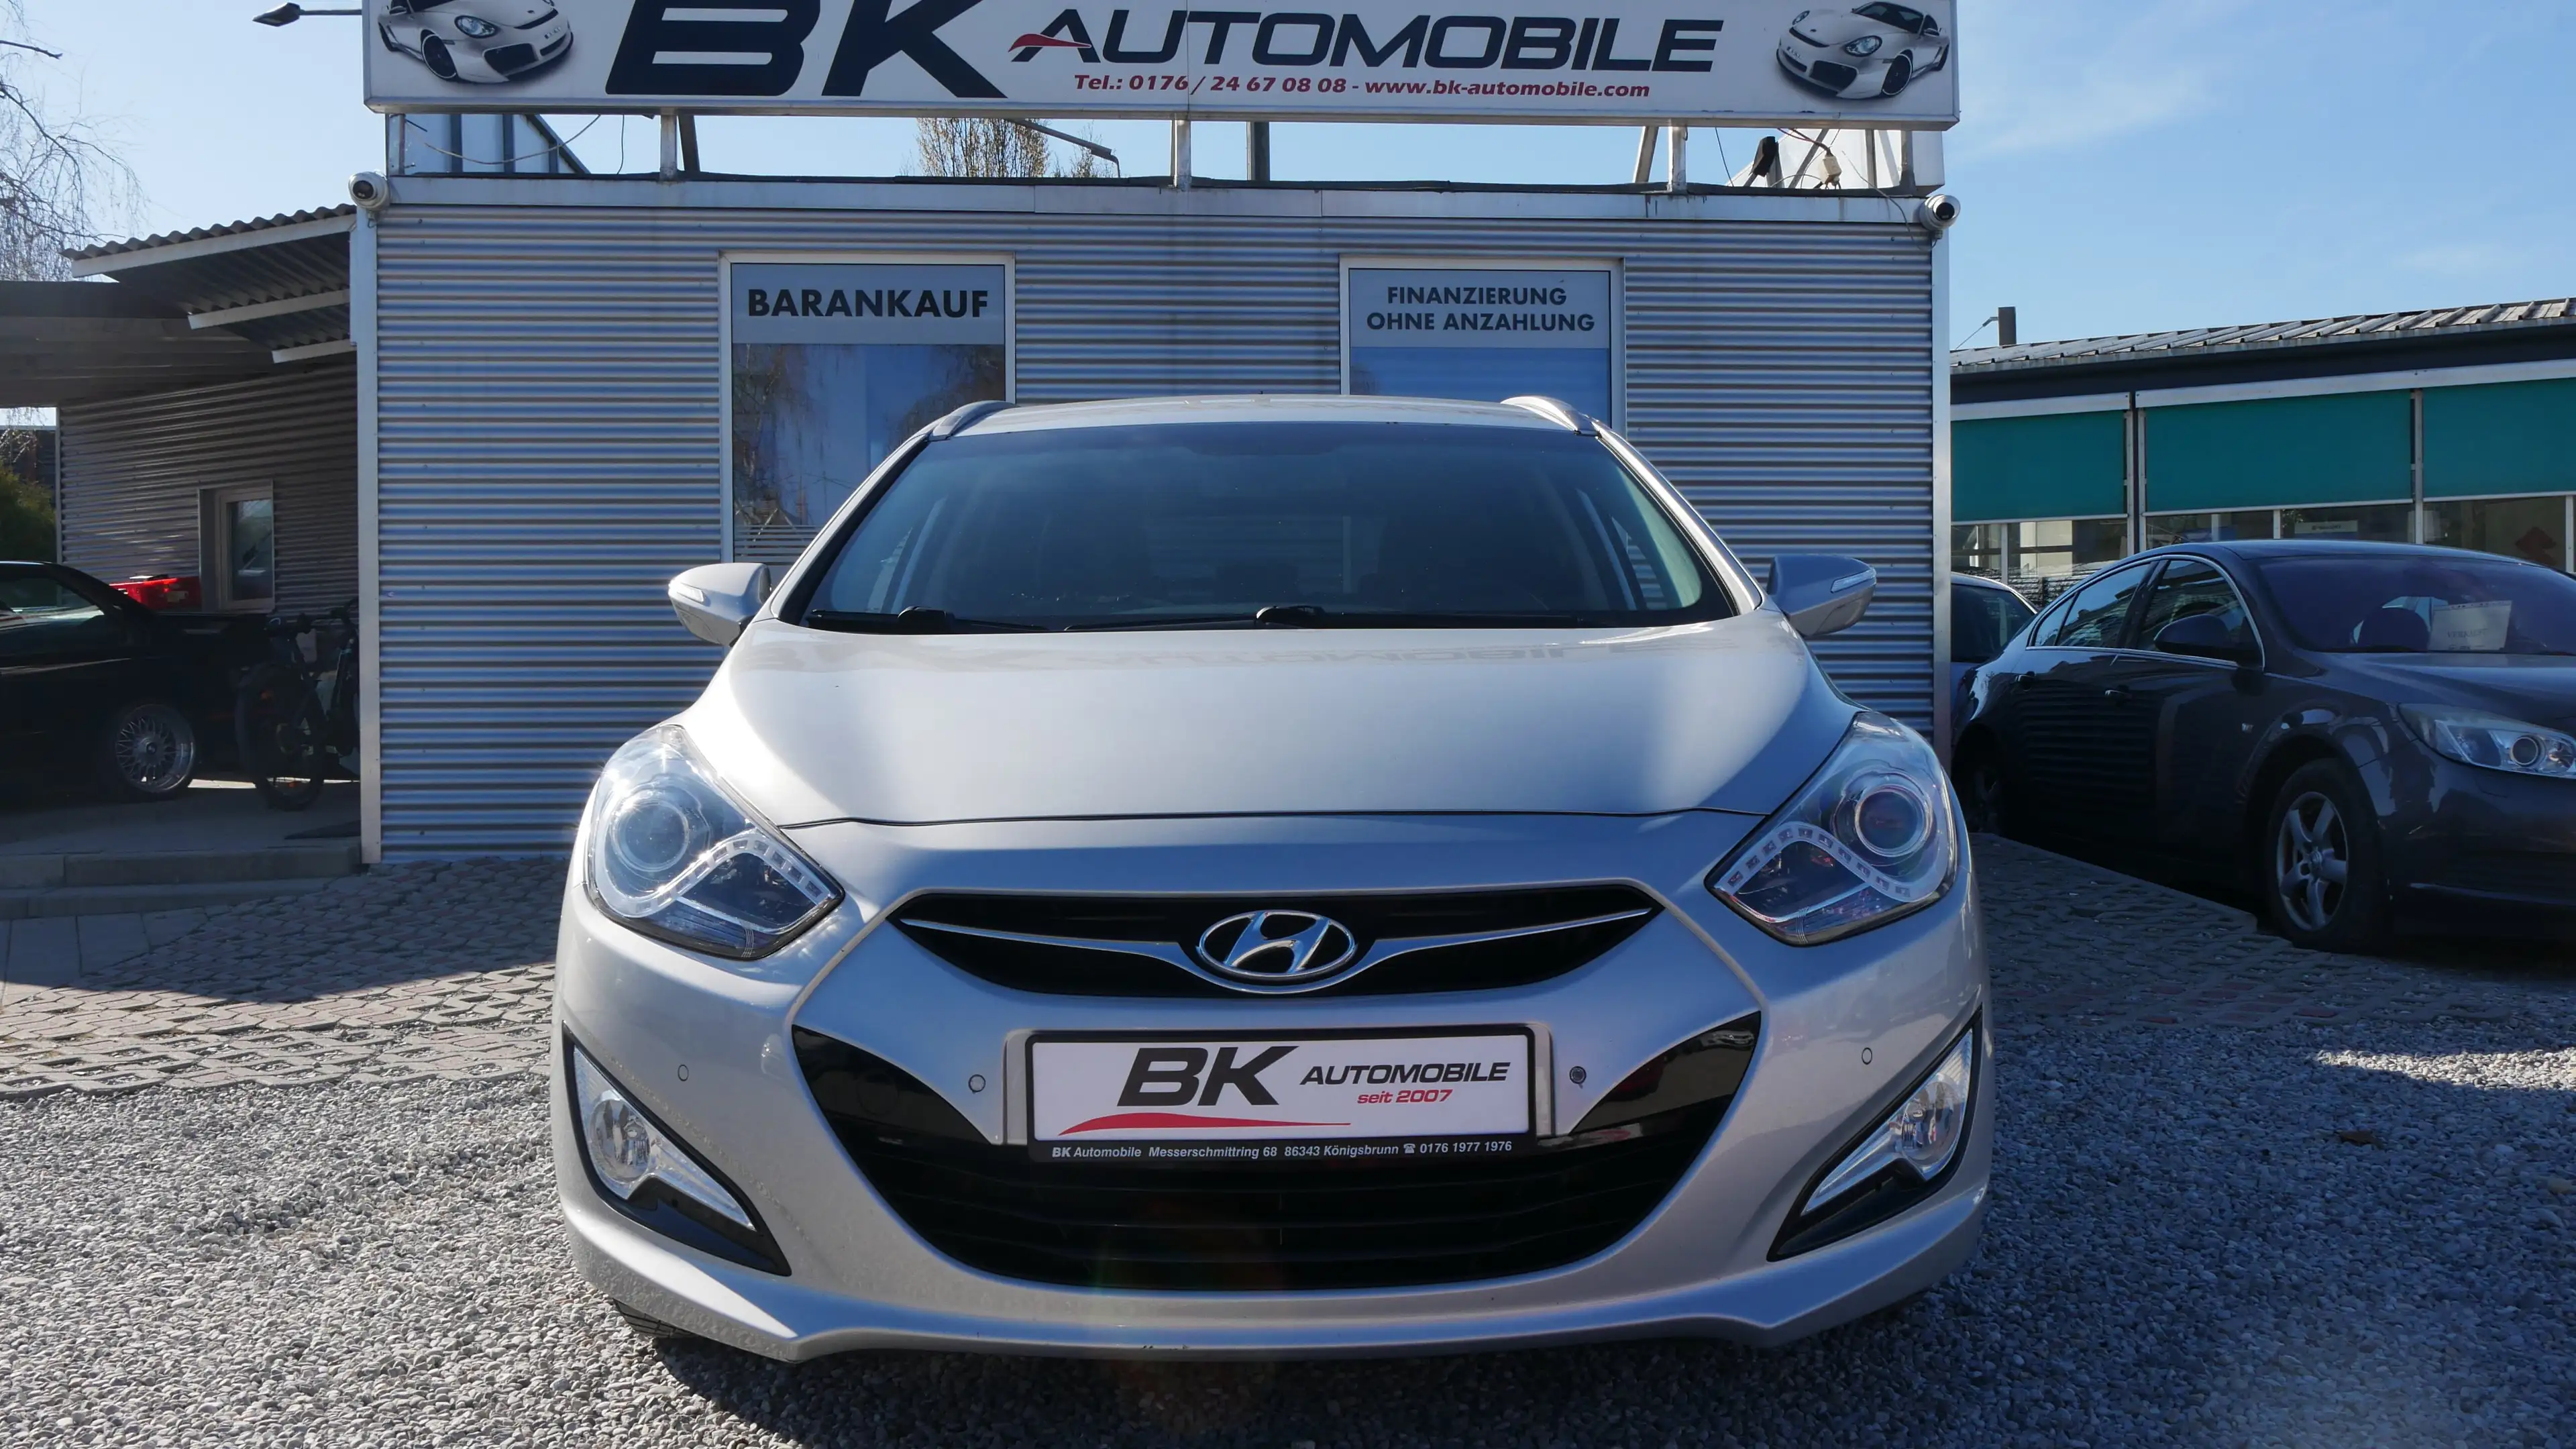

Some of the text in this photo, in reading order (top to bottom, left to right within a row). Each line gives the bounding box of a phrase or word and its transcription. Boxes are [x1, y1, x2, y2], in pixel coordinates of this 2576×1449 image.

[605, 0, 1724, 98] BK AUTOMOBILE
[1074, 74, 1122, 91] Tel.:
[1128, 75, 1189, 91] 0176
[1210, 76, 1240, 92] 24
[1246, 77, 1276, 93] 67
[1282, 77, 1312, 93] 08
[1317, 78, 1347, 93] 08
[1364, 80, 1650, 98] www.bk-automobile.com
[748, 289, 988, 318] BARANKAUF
[1387, 286, 1567, 306] FINANZIERUNG
[1366, 312, 1595, 332] OHNE ANZAHLUNG
[1117, 1046, 1511, 1107] BK AUTOMOBILE
[1357, 1089, 1453, 1104] seit 2007
[1052, 1140, 1512, 1159] BK Automobile Messerschmittring 68 86343 Königsbrunn 0176 1977 1976
